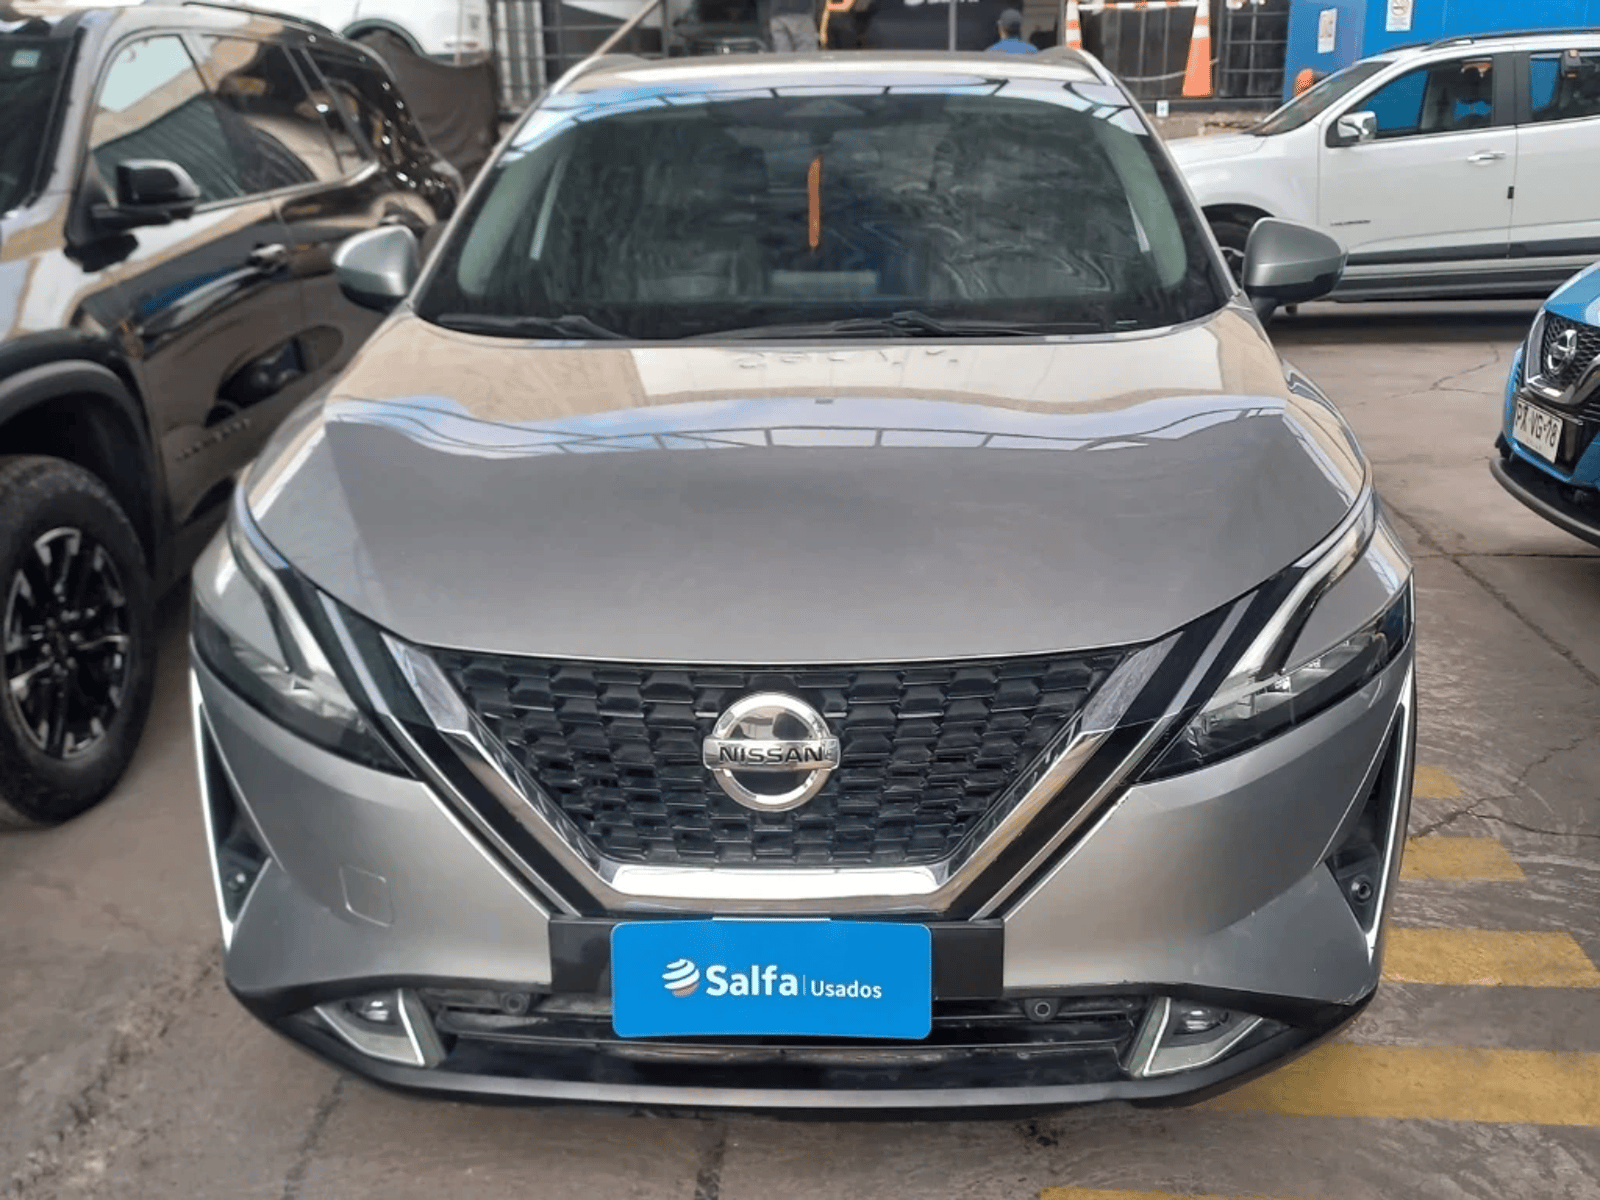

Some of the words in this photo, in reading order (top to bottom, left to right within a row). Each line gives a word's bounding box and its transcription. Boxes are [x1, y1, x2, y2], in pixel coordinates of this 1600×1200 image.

[719, 746, 824, 763] NISSAN
[706, 965, 799, 997] Salfa
[811, 980, 882, 999] Usados
